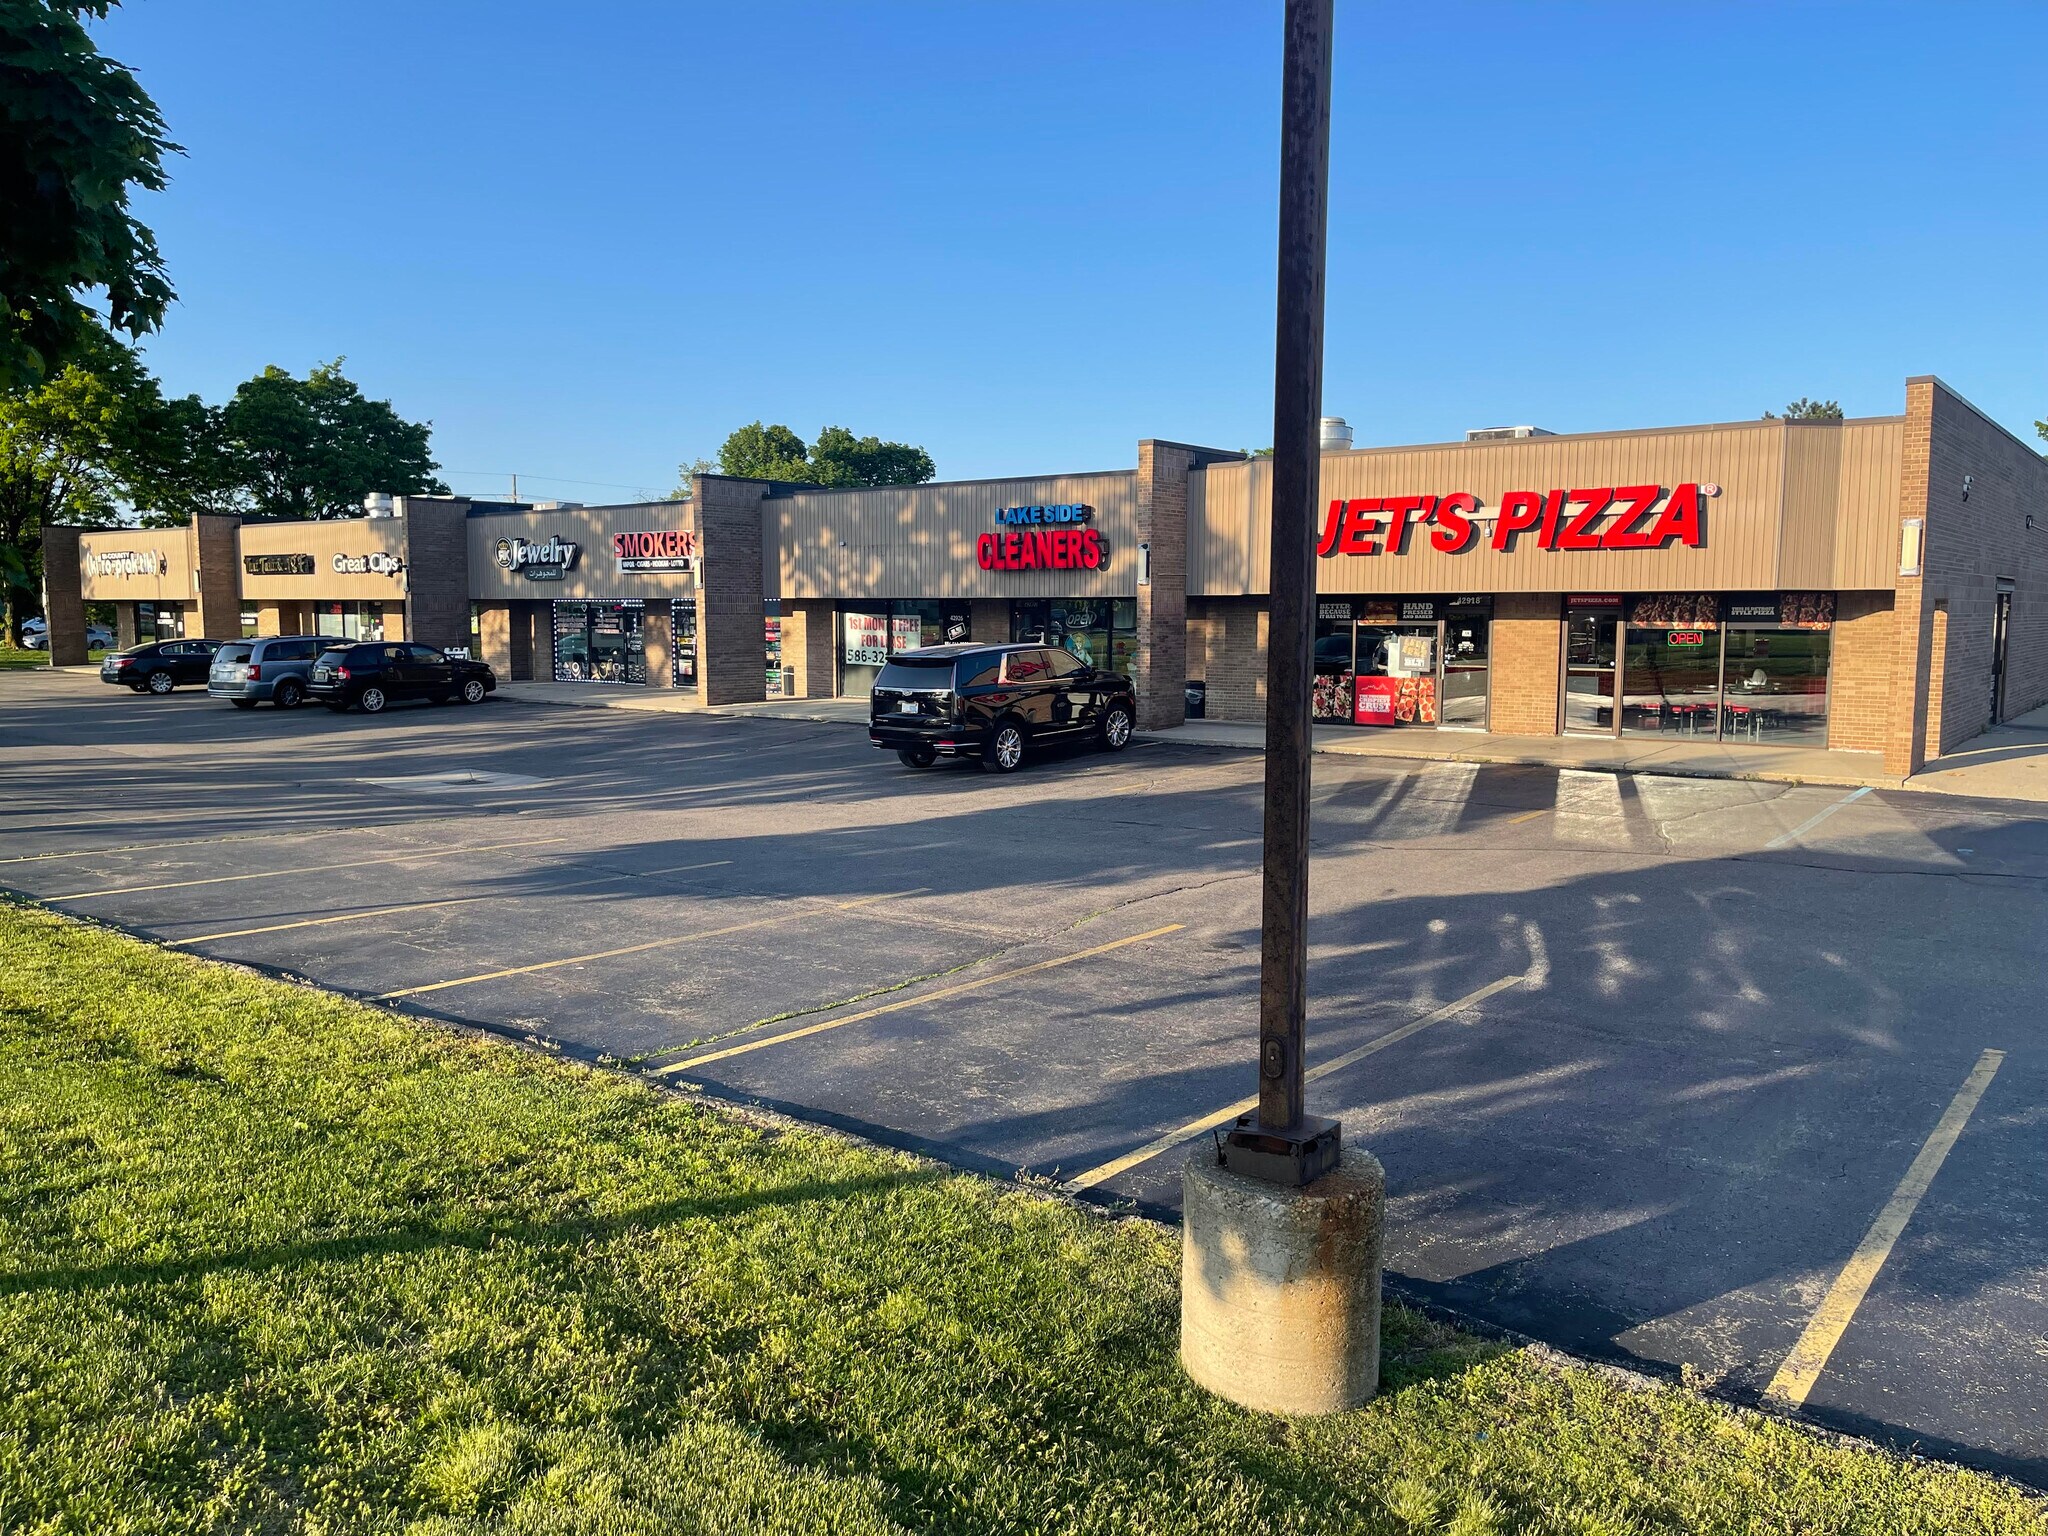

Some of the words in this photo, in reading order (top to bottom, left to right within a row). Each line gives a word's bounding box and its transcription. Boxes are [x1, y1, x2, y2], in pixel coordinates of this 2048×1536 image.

[995, 505, 1041, 524] LAKE
[1043, 504, 1083, 523] SIDE
[1317, 493, 1475, 556] JET'S
[1491, 483, 1699, 550] PIZZA
[509, 537, 577, 571] Jewelry
[977, 529, 1100, 570] CLEANERS
[332, 553, 367, 573] Great
[369, 552, 400, 577] Clips
[1403, 602, 1434, 610] HAND
[864, 617, 897, 631] MONH
[898, 618, 920, 632] FREE
[1067, 613, 1094, 625] OPEN
[861, 634, 878, 648] FOR
[880, 635, 907, 649] LASE
[1669, 633, 1702, 645] OPEN
[847, 649, 899, 664] 586-32
[1358, 702, 1391, 710] CRUST
